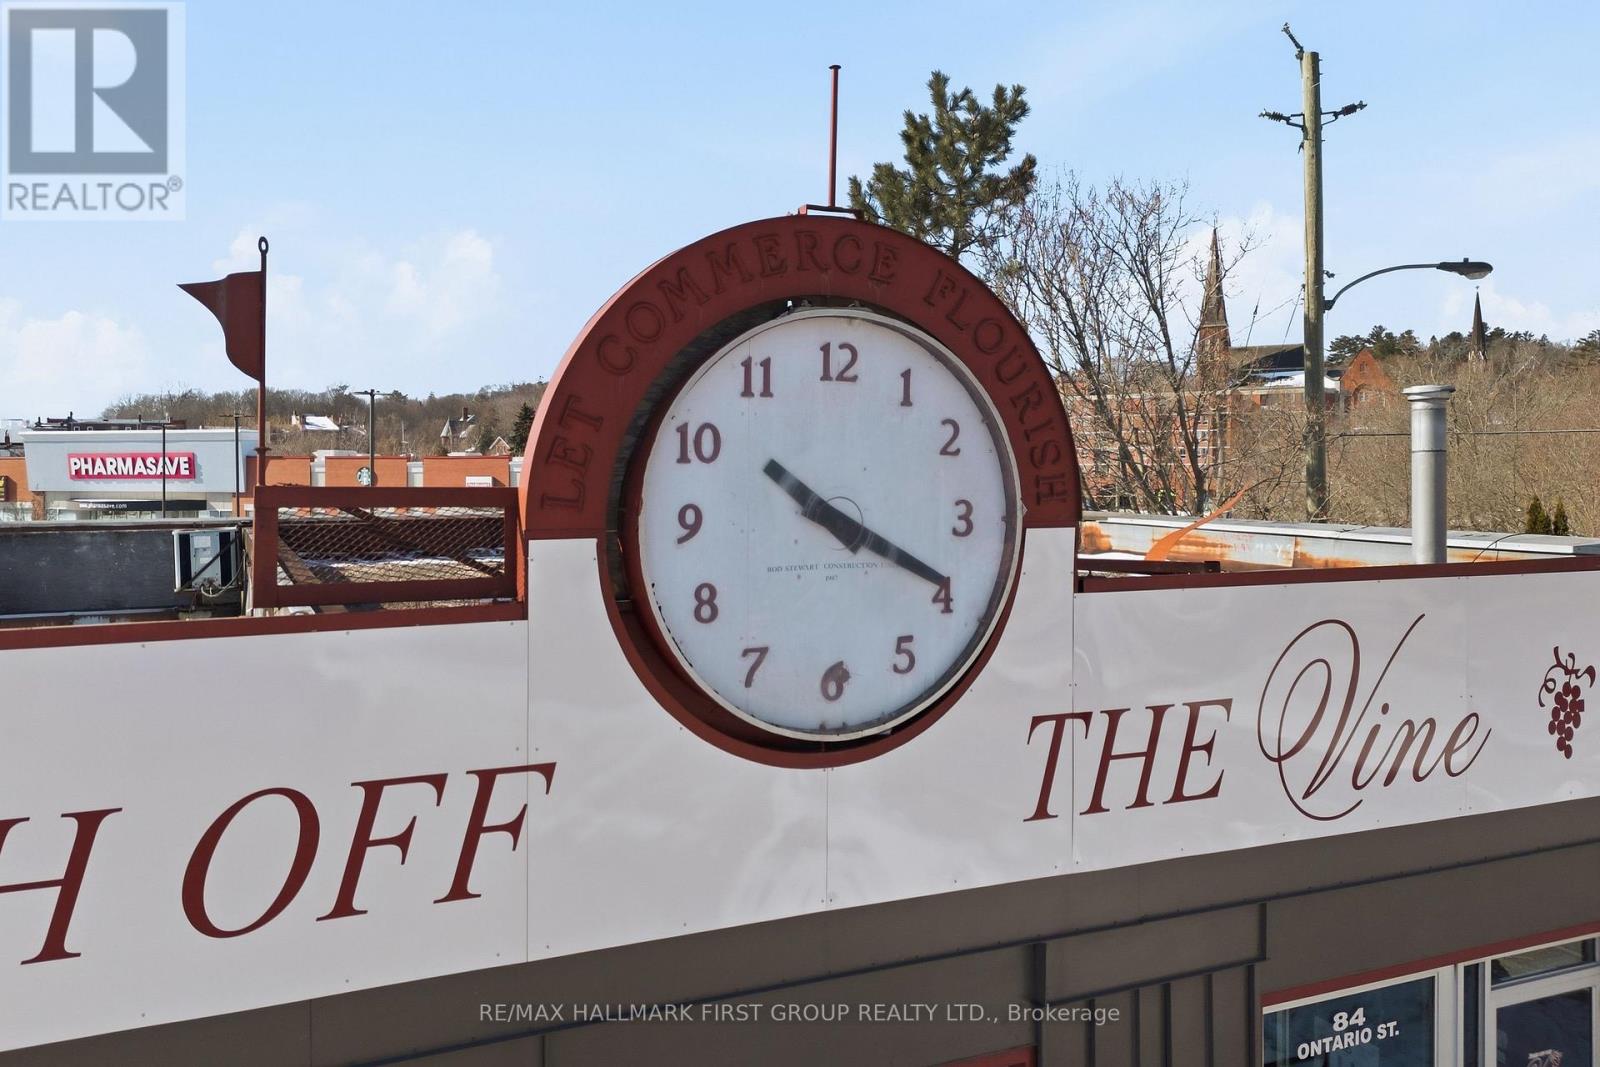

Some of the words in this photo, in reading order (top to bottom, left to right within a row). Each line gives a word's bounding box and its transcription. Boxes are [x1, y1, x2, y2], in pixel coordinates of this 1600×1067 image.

[540, 394, 603, 513] LET
[596, 229, 901, 377] COMMERCE
[923, 267, 1068, 507] FLOURISH
[740, 356, 774, 398] 11
[819, 342, 859, 383] 12
[900, 368, 913, 407] 1
[676, 422, 722, 464] 10
[939, 418, 961, 457] 2
[69, 456, 190, 476] PHARMASAVE
[676, 503, 703, 545] 9
[952, 499, 974, 538] 3
[823, 561, 879, 569] CONSTRUCTION
[693, 582, 719, 624] 8
[932, 576, 954, 614] 4
[741, 646, 770, 688] 7
[892, 635, 916, 674] 5
[820, 660, 851, 701] 6
[181, 762, 557, 939] OFF
[1023, 698, 1233, 822] THE
[1257, 613, 1492, 821] Vine
[1332, 1007, 1366, 1032] 84
[1297, 1028, 1372, 1060] ONTARIO
[1376, 1021, 1400, 1039] ST.
